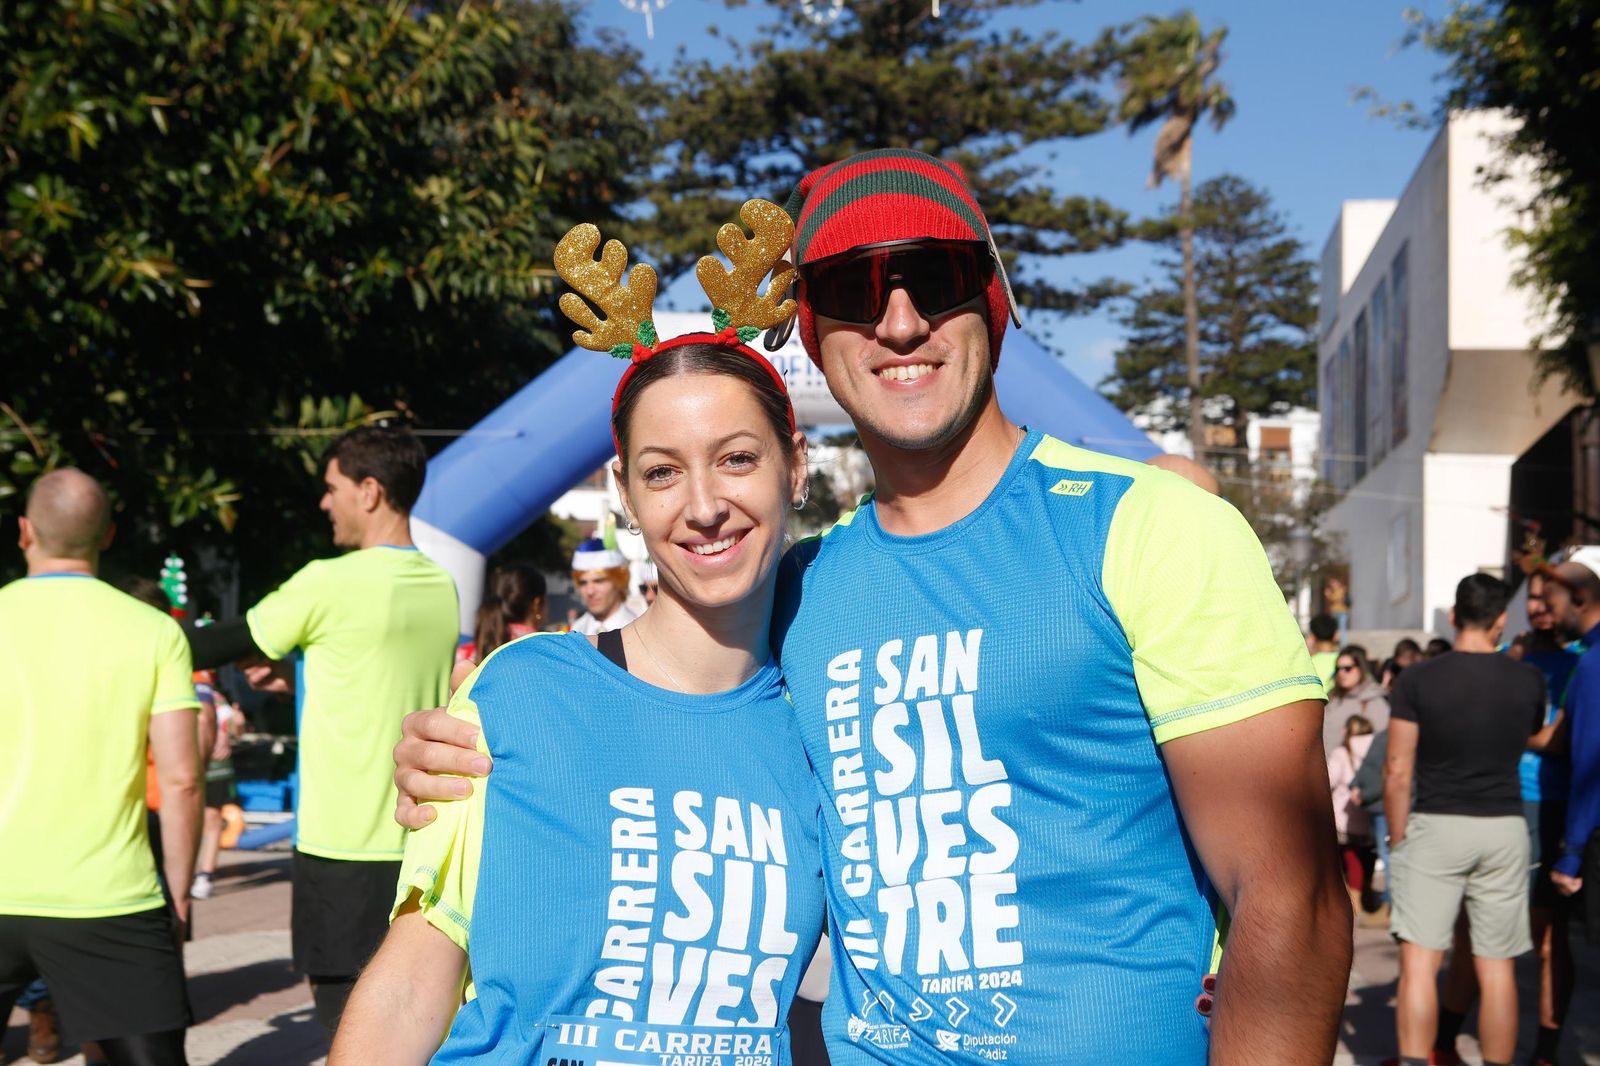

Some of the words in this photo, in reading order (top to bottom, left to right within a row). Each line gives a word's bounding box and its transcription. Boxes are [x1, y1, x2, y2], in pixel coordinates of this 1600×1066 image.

[1068, 482, 1088, 495] RH
[874, 629, 983, 705] SAN
[825, 649, 873, 898] CARRERA
[872, 694, 1009, 796] SIL
[673, 791, 788, 865] SAN
[873, 783, 1020, 887] VES
[585, 787, 658, 1023] CARRERA
[662, 850, 798, 955] SIL
[877, 872, 1024, 976] TRE
[648, 942, 789, 1028] VES
[921, 978, 974, 994] TARIFA
[978, 970, 1022, 990] 2024
[557, 1023, 600, 1048] III
[615, 1028, 773, 1056] CARRERA
[659, 1054, 722, 1066] TARIFA
[735, 1055, 772, 1066] 2024
[863, 1029, 911, 1043] TARIFA
[963, 1033, 1017, 1048] Diputación
